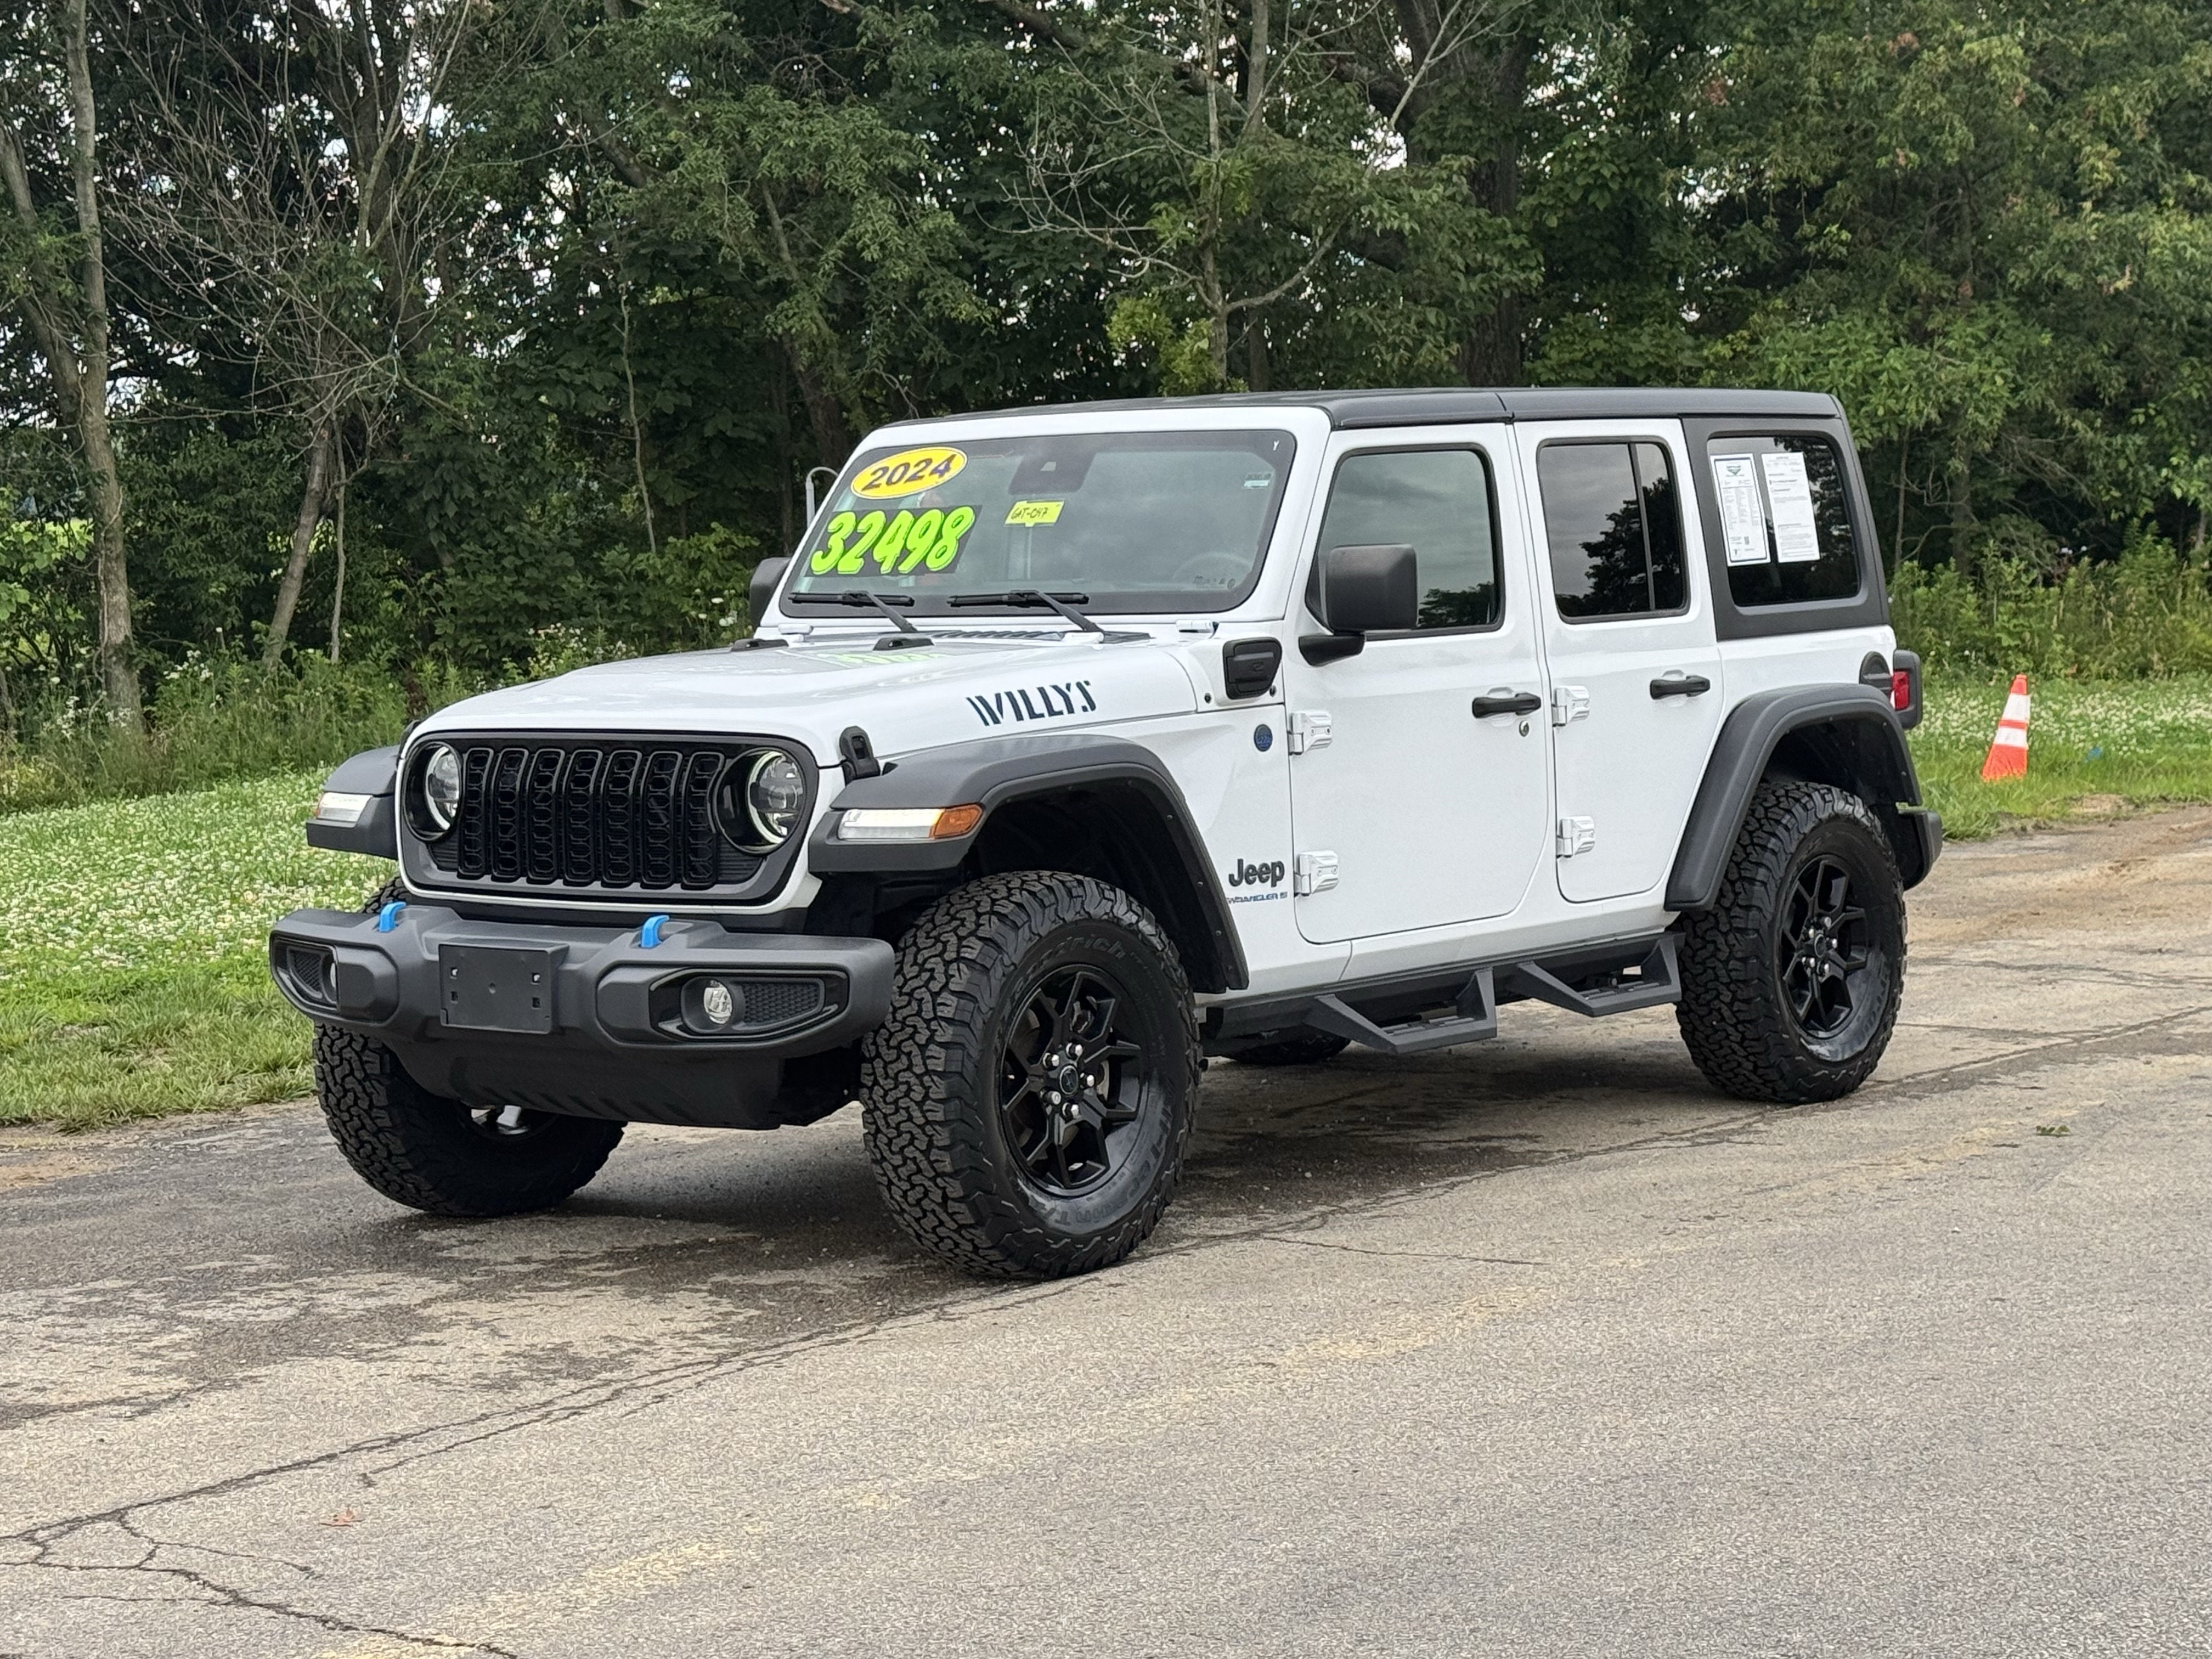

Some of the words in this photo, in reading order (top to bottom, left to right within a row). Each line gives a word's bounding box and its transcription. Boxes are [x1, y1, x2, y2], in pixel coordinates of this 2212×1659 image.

[861, 454, 957, 491] 2024
[810, 506, 975, 574] 32498
[966, 680, 1096, 726] WILLYS
[1228, 859, 1285, 888] Jeep
